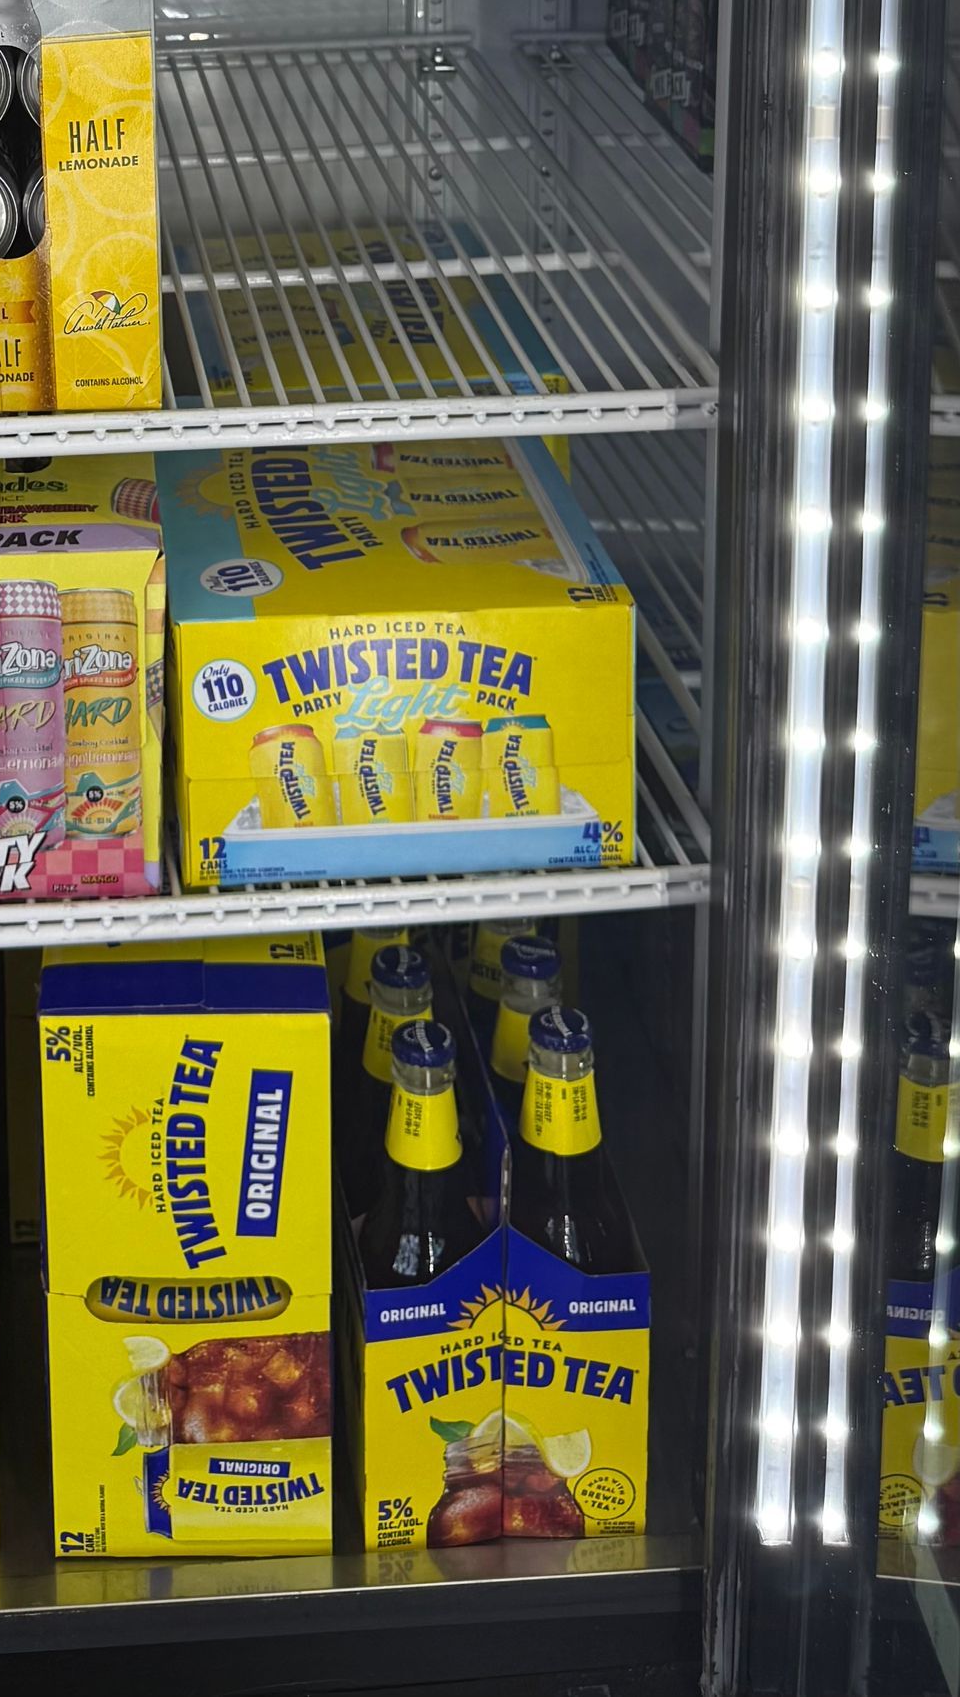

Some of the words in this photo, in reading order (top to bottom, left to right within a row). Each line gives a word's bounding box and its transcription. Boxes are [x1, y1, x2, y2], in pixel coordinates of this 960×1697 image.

[69, 118, 126, 153] HALF
[59, 155, 139, 171] LEMONADE
[330, 623, 376, 639] HARD
[387, 621, 425, 633] ICED
[435, 622, 465, 636] TEA
[202, 664, 230, 680] Only
[262, 639, 453, 703] TWISTED
[458, 640, 533, 696] TEA
[202, 674, 244, 700] 110
[208, 696, 248, 712] CALORIES
[293, 691, 342, 718] PARTY
[334, 675, 471, 730] Light
[476, 691, 517, 711] PACK
[583, 821, 624, 844] 4%
[200, 837, 226, 860] 12
[200, 859, 228, 870] CANS
[46, 1026, 71, 1062] 5%
[169, 1039, 223, 1104] TEA
[245, 1089, 283, 1220] ORIGINAL
[166, 1114, 227, 1270] TWISTED
[380, 1303, 446, 1323] ORIGINAL
[569, 1299, 635, 1313] ORIGINAL
[440, 1336, 484, 1355] HARD
[491, 1330, 524, 1346] ICED
[532, 1339, 562, 1353] TEA
[386, 1344, 555, 1414] TWISTED
[563, 1356, 635, 1405] TEA
[378, 1497, 412, 1520] 5%
